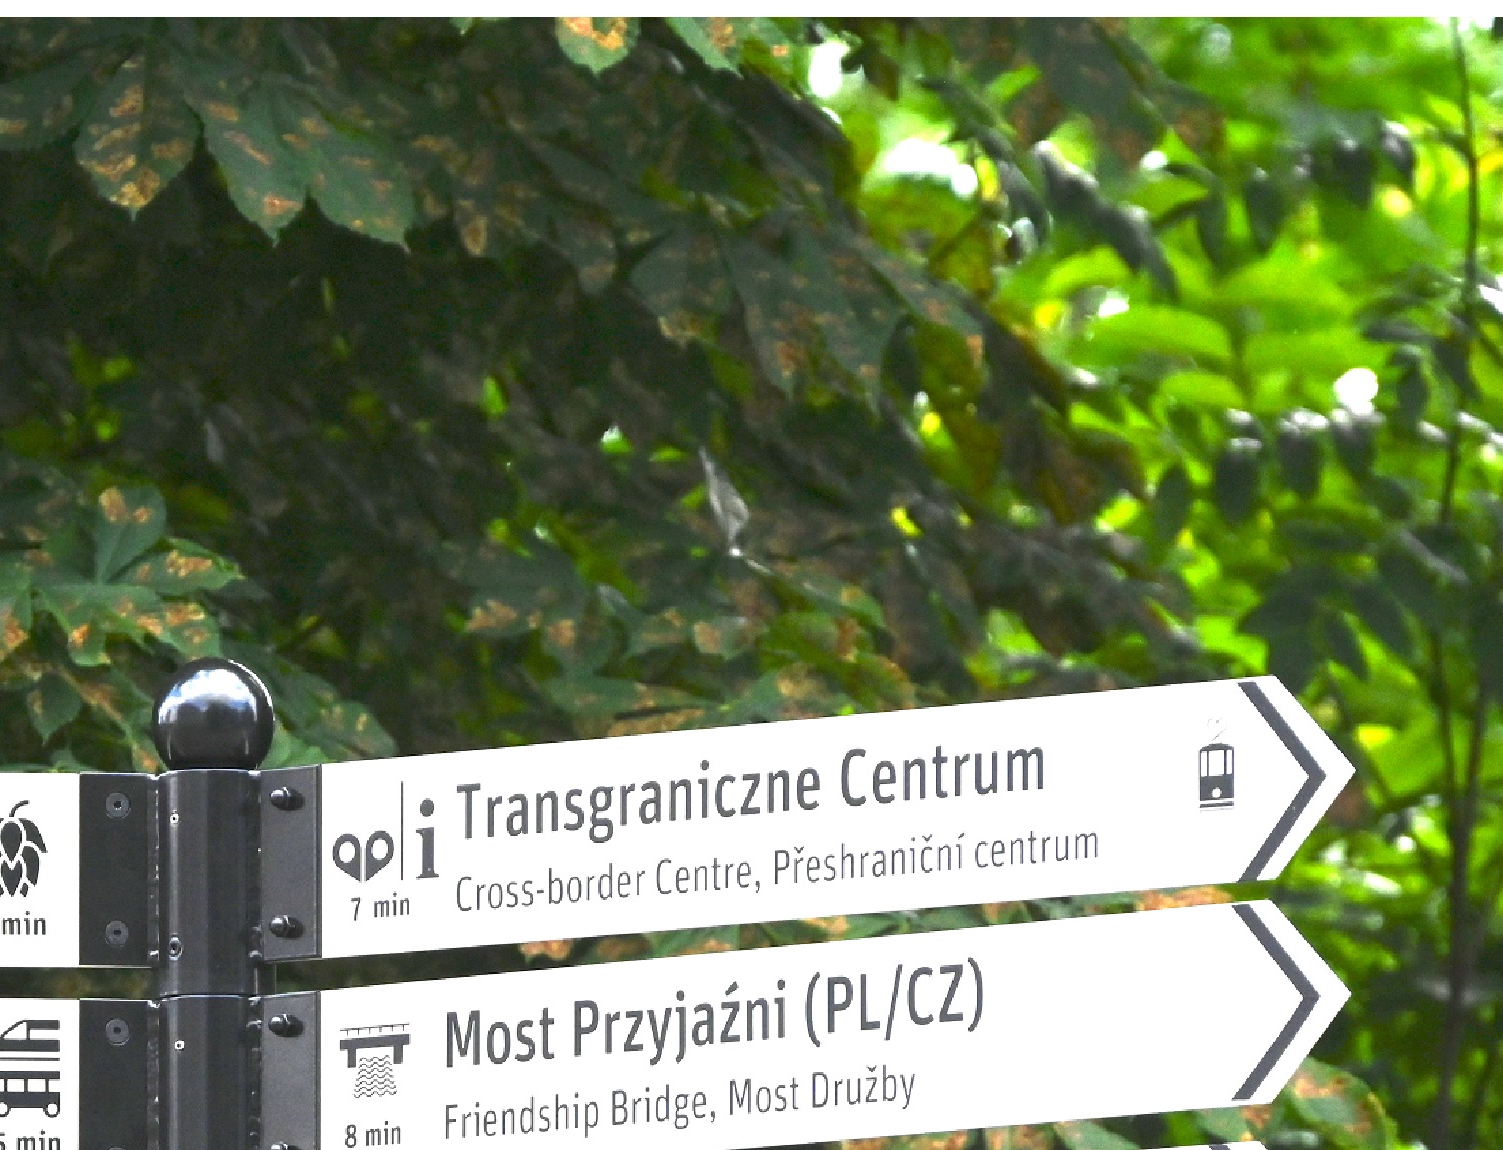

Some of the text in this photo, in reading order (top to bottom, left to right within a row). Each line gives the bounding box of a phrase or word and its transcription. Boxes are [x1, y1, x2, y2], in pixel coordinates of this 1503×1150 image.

[456, 745, 1044, 844] Transgraniczne Centrum
[350, 892, 410, 922] 7 min
[456, 830, 1099, 912] Cross-border Centre, Přeshraniční centrum
[2, 910, 47, 936] min
[446, 957, 984, 1069] Most Przyjaźni (PL/CZ)
[344, 1120, 401, 1149] 8 min
[445, 1064, 916, 1140] Friendship Bridge, Most Družby
